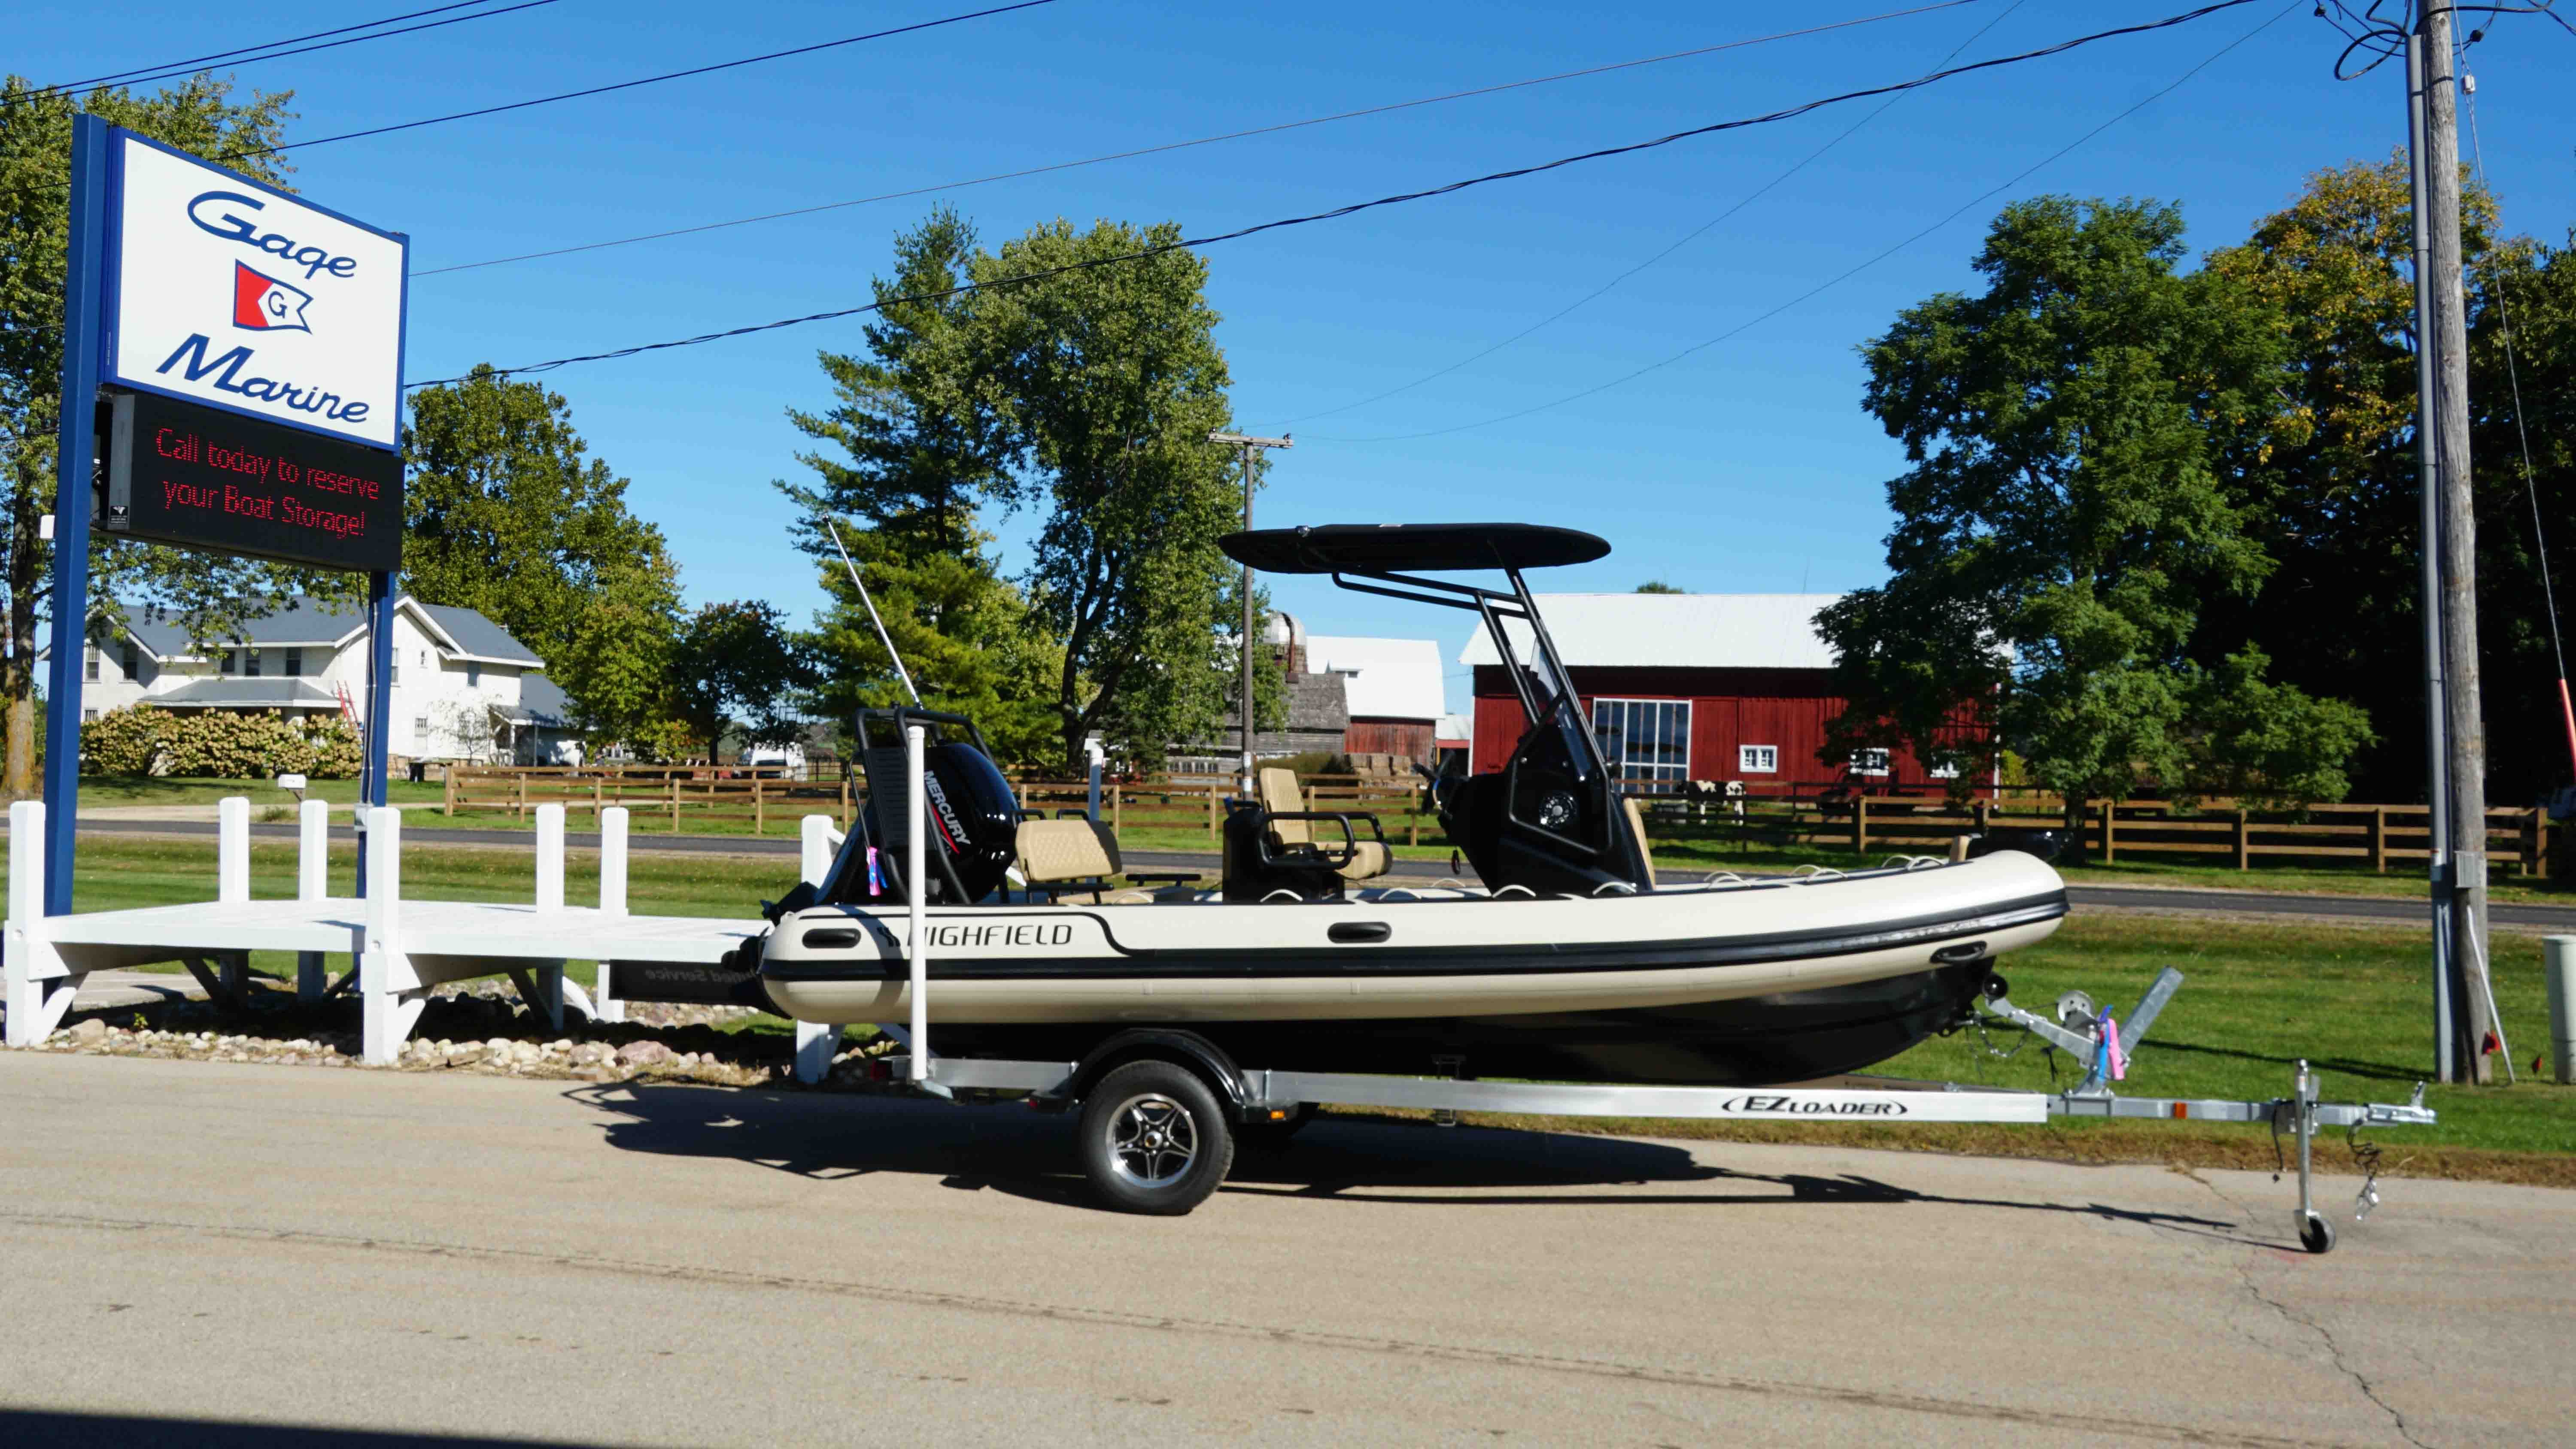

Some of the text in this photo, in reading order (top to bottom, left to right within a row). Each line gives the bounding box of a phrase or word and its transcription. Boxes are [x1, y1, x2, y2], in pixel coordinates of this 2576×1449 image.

[187, 191, 356, 279] Gage
[267, 291, 288, 319] G
[155, 333, 369, 423] Marine
[155, 428, 380, 500] Call today to reserve
[163, 480, 365, 539] your Boat Storage!
[924, 770, 971, 845] MERCURY
